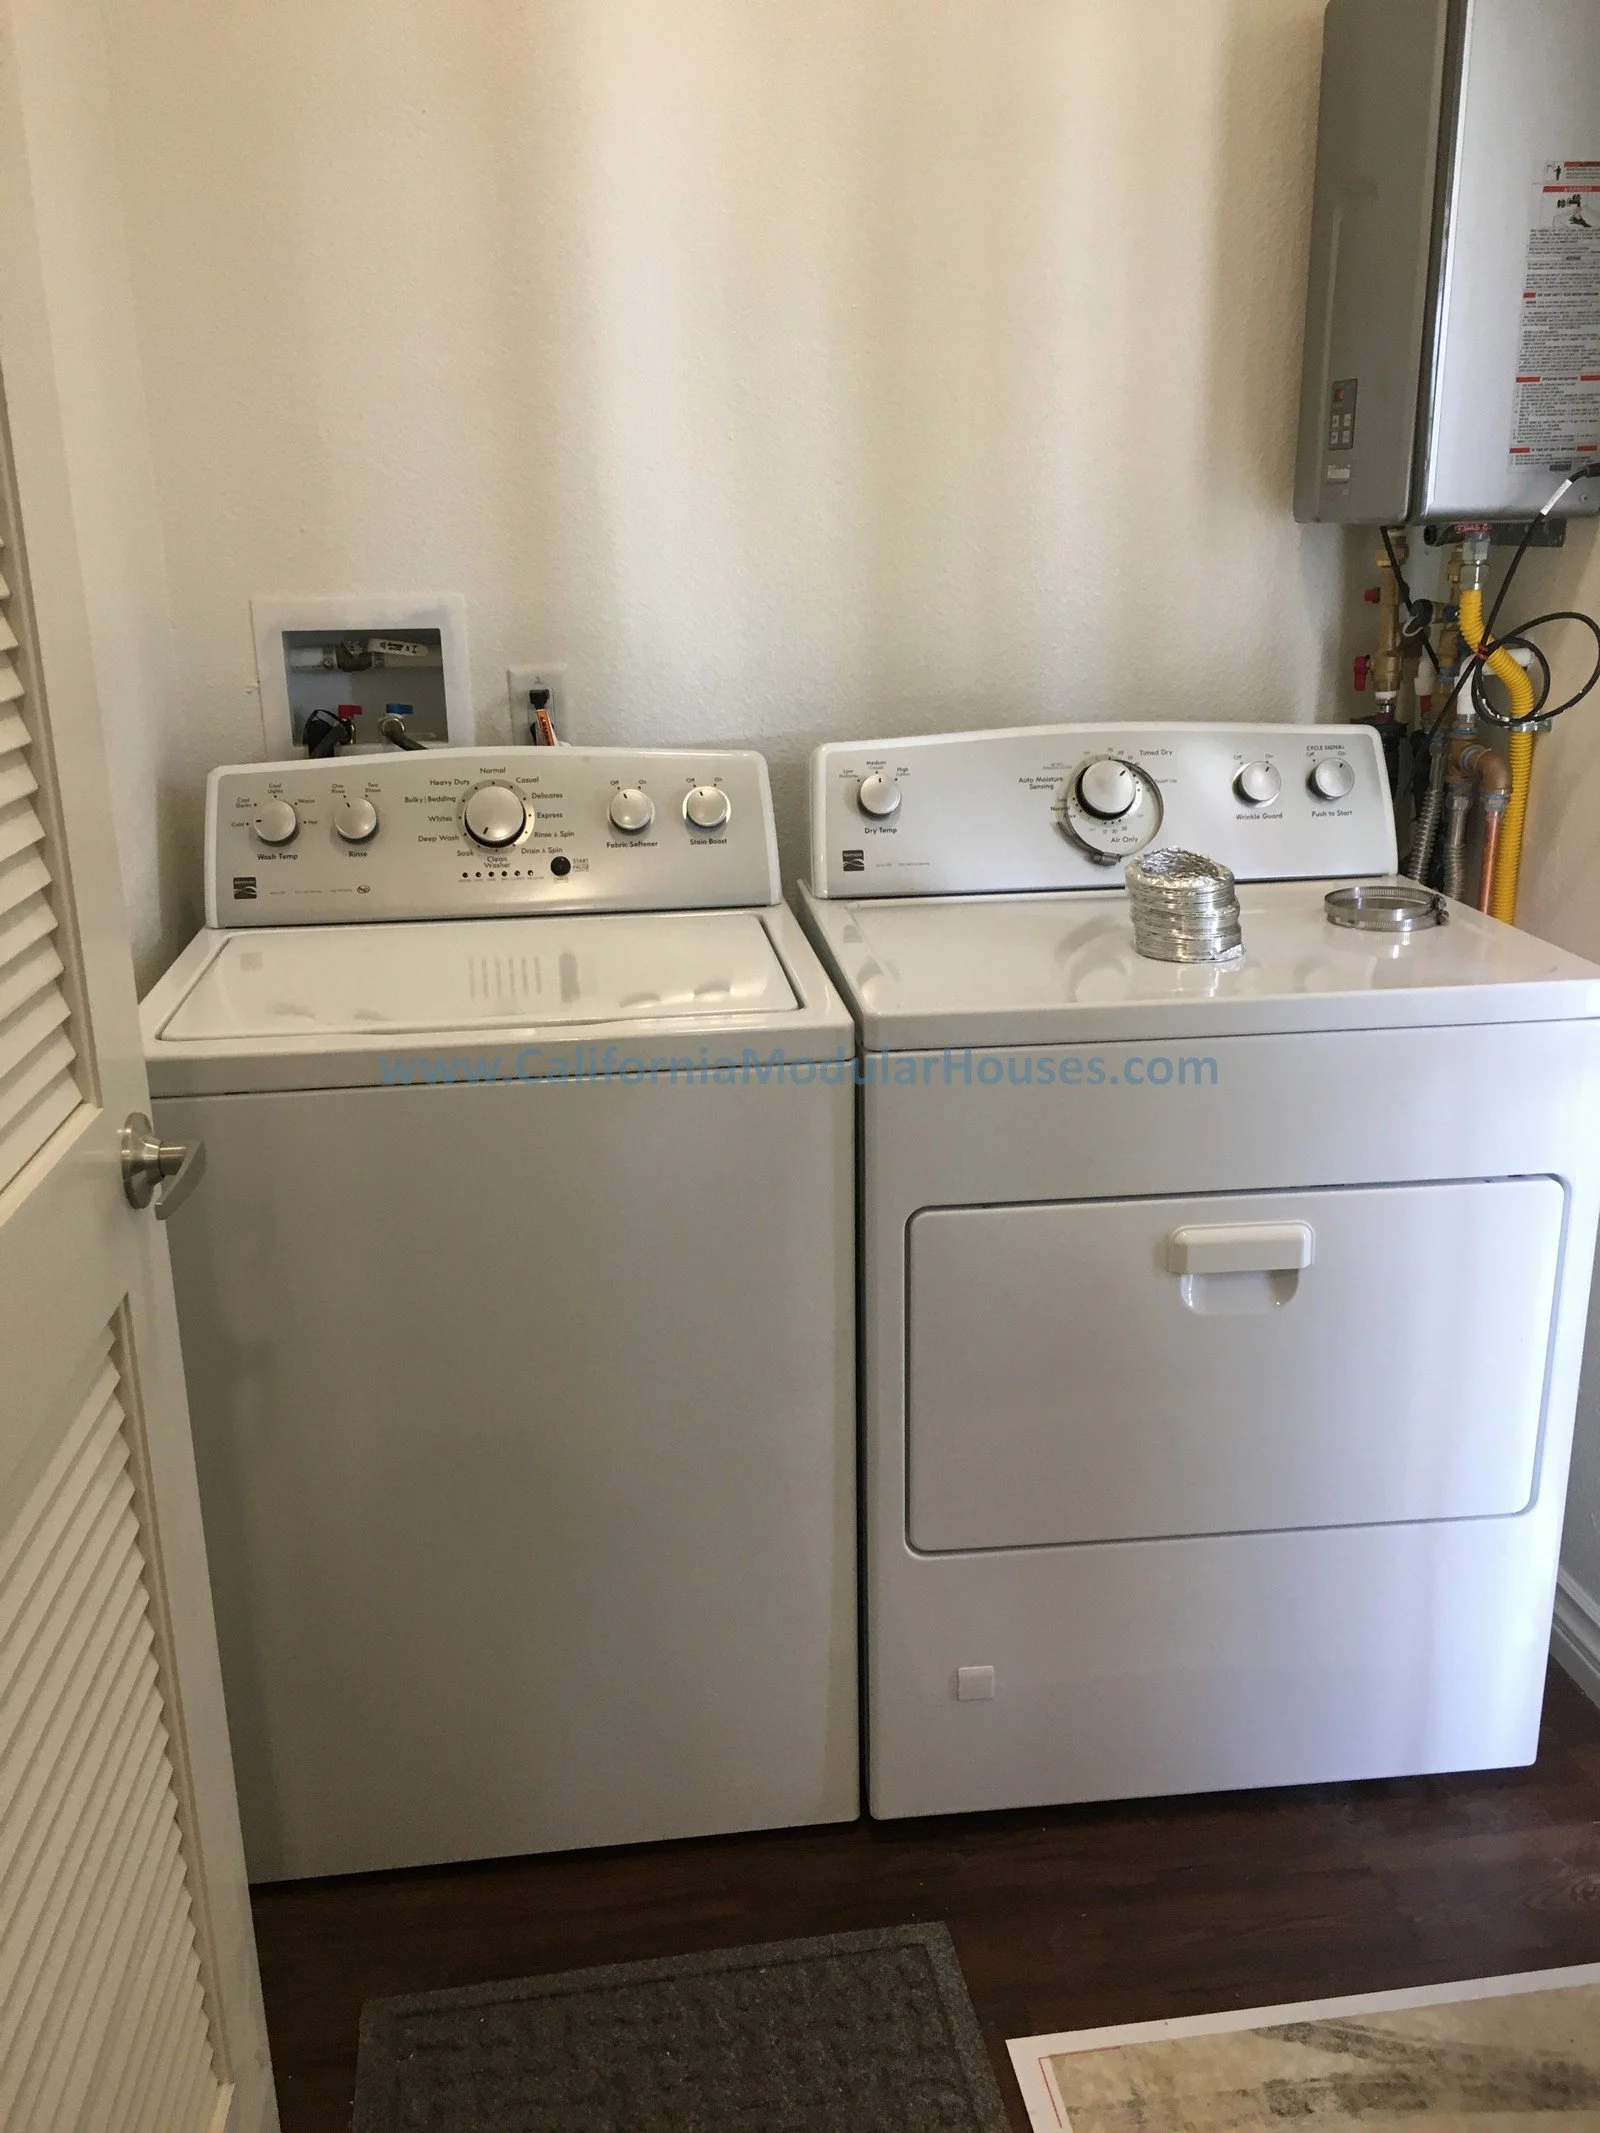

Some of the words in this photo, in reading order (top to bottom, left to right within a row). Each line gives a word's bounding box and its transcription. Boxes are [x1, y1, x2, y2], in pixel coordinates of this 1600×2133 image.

[480, 767, 507, 775] Normal
[430, 779, 452, 787] Heavy
[453, 778, 471, 786] Duty
[515, 776, 540, 784] Casual
[1018, 776, 1034, 784] Auto
[1035, 775, 1064, 783] Moisture
[1029, 783, 1054, 791] Sensing
[531, 792, 564, 800] Delicates
[536, 811, 563, 820] Express
[1311, 810, 1327, 818] Push
[427, 815, 453, 823] Whites
[559, 831, 576, 839] Spin
[864, 827, 877, 835] Dry
[878, 827, 898, 835] Temp
[689, 838, 707, 846] Stain
[1122, 836, 1139, 844] Only
[606, 841, 628, 849] Fabric
[629, 840, 659, 848] Softener
[348, 850, 369, 859] Rinse
[521, 847, 540, 855] Drain
[547, 847, 564, 855] Spin
[257, 853, 277, 861] Wash
[278, 853, 299, 861] Temp
